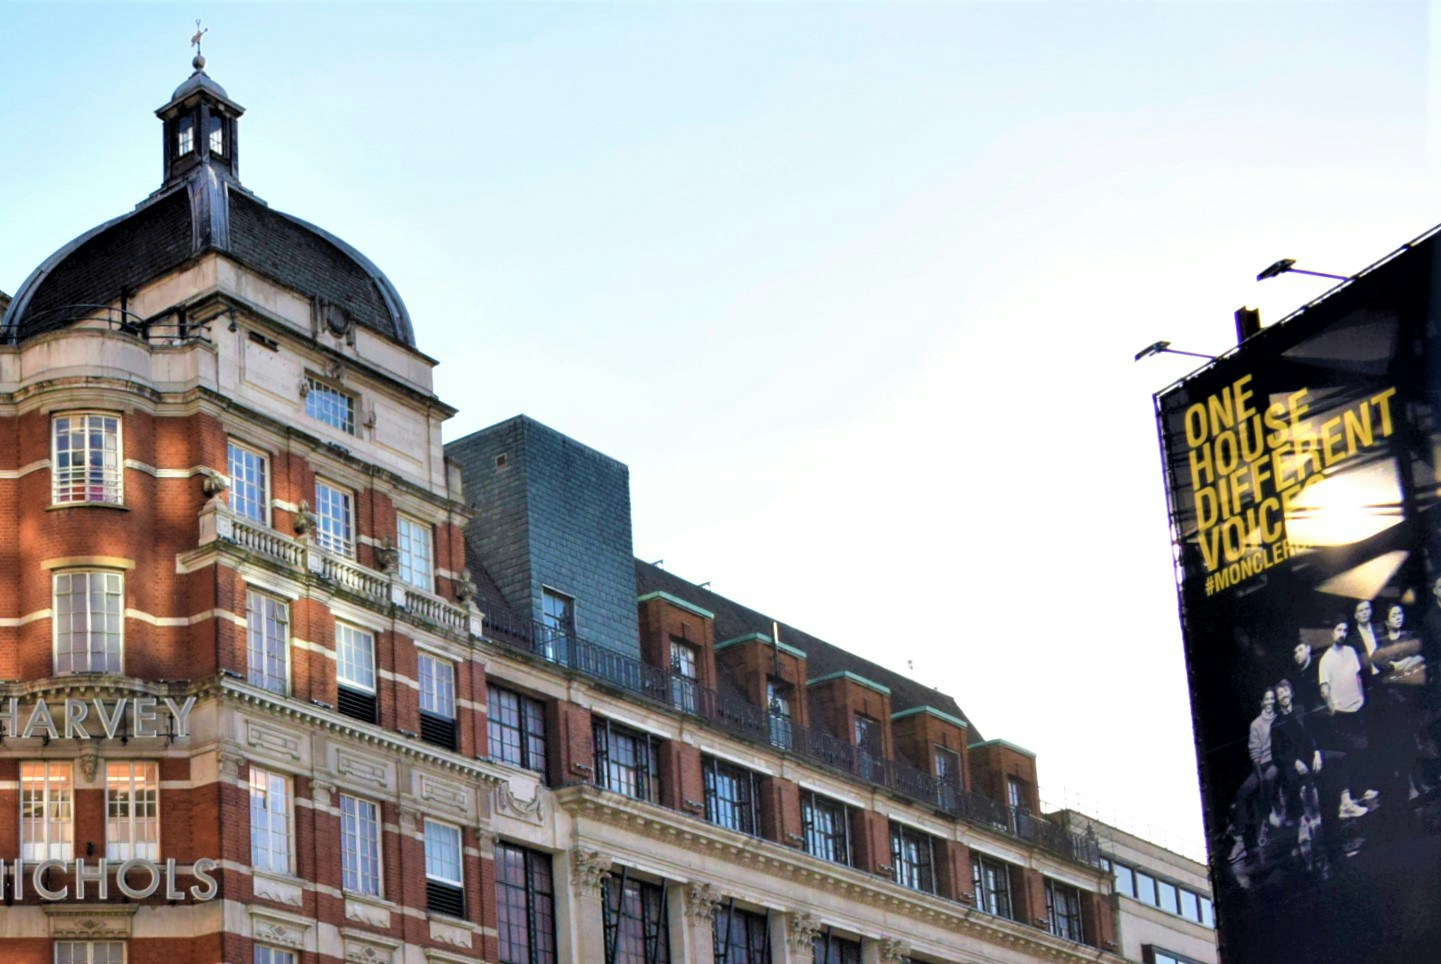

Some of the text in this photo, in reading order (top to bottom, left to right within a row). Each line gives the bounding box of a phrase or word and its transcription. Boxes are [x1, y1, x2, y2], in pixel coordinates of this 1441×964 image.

[1184, 373, 1257, 448] ONE
[1188, 387, 1312, 491] HOUSE
[1194, 386, 1397, 532] DIFFERENT
[1198, 473, 1327, 573] VOIC
